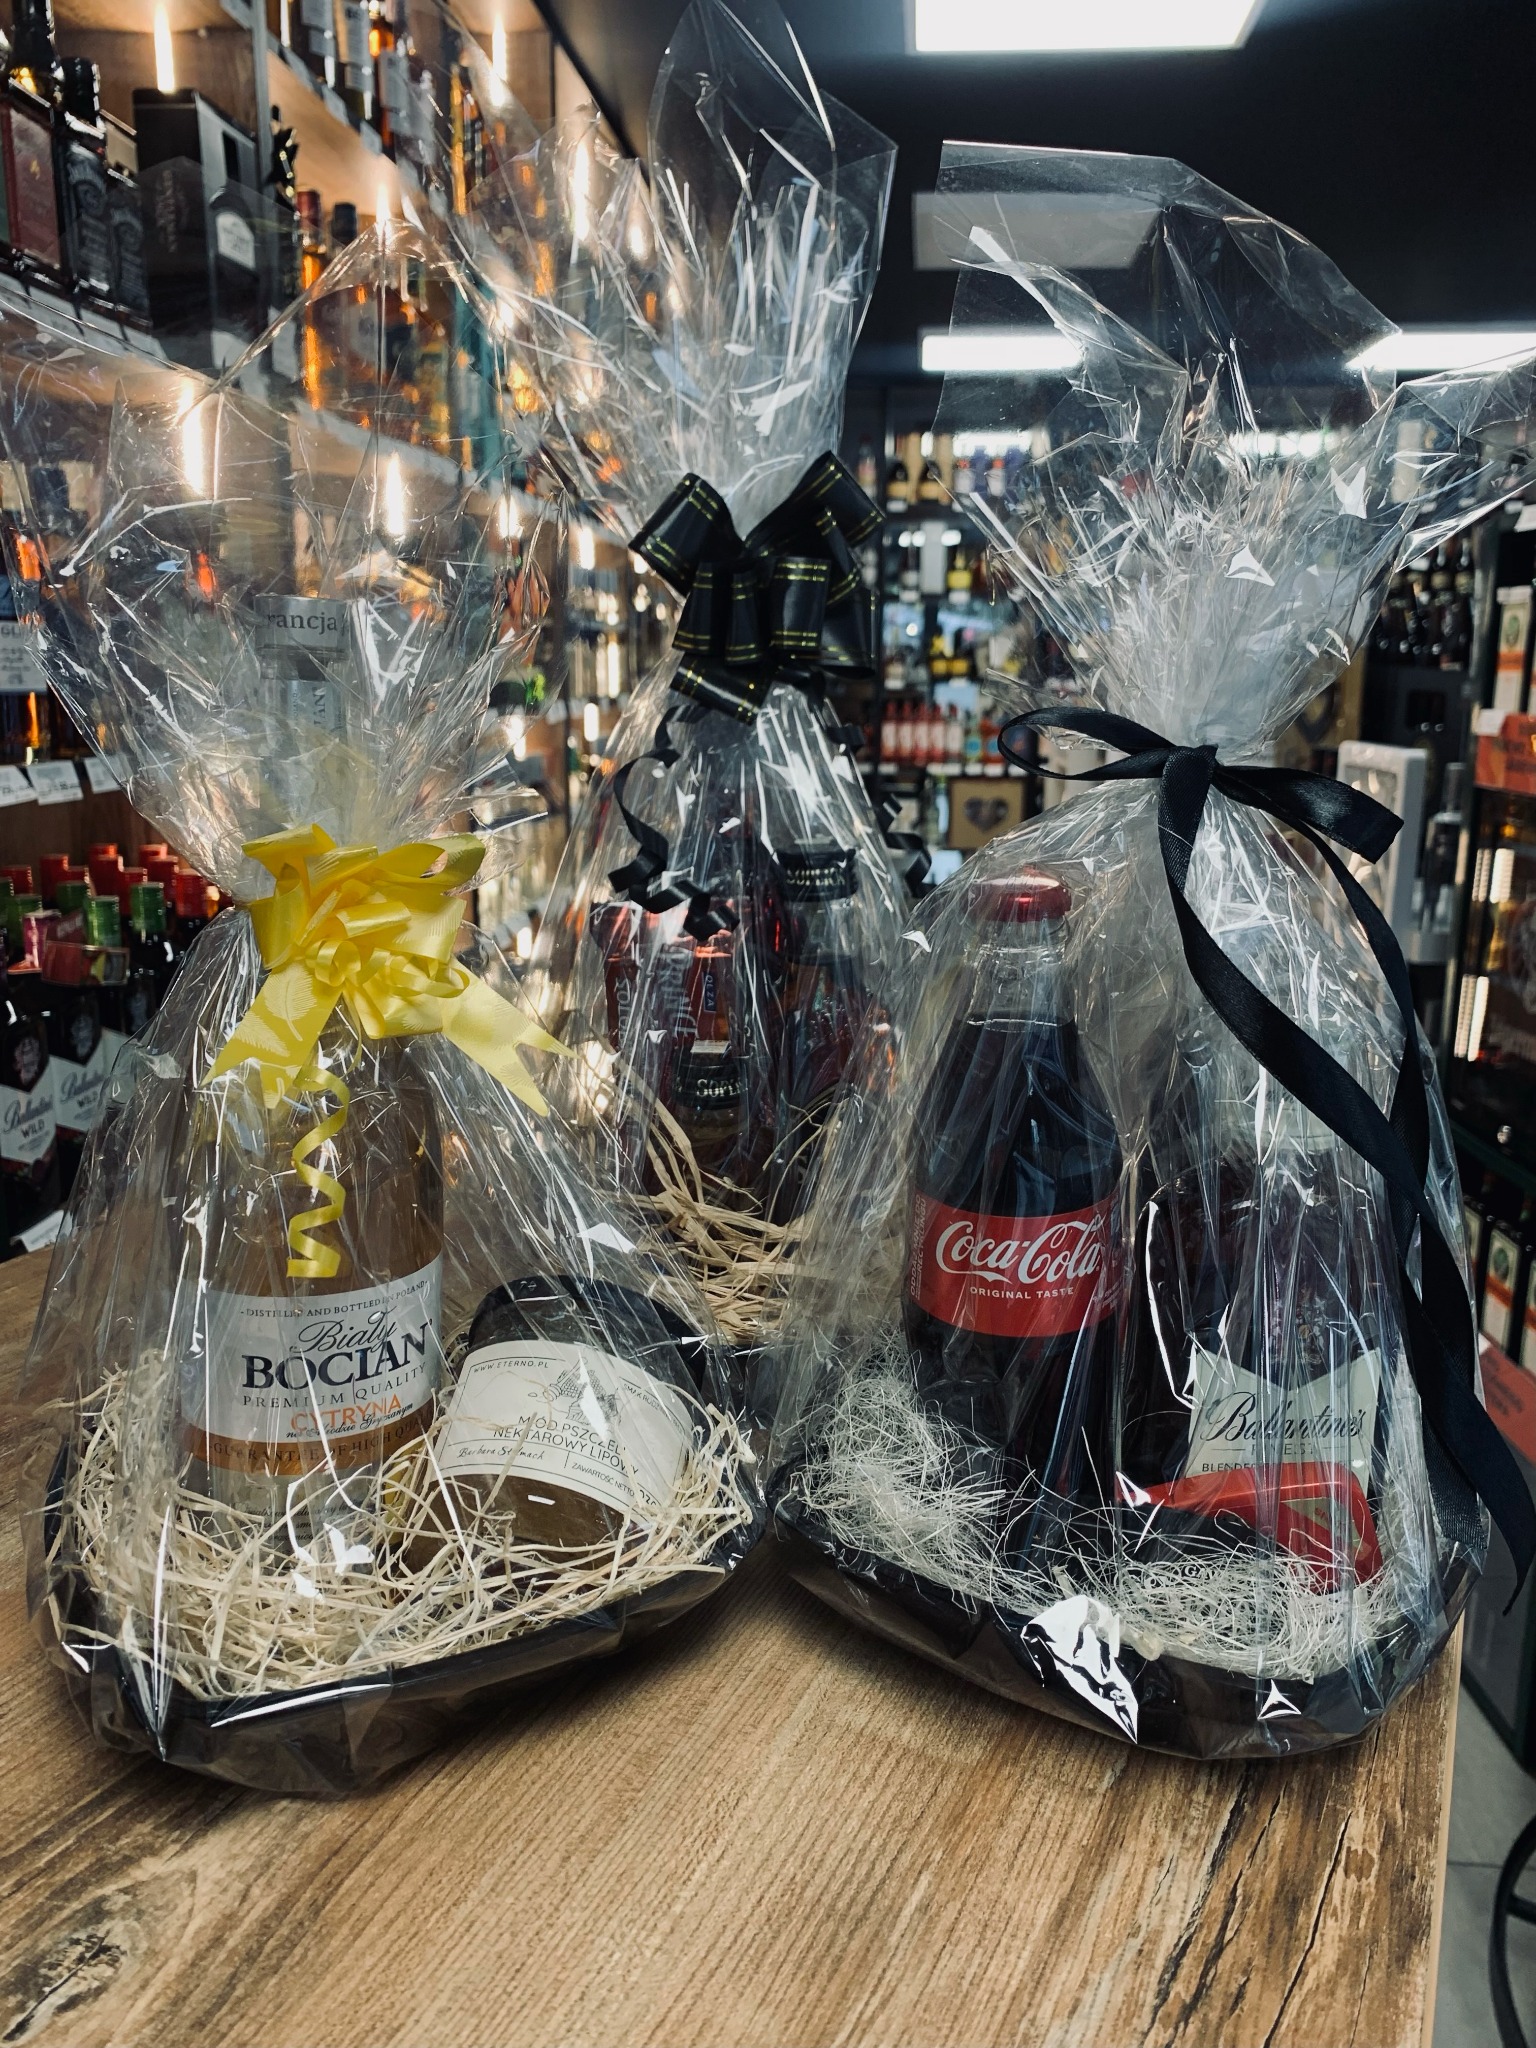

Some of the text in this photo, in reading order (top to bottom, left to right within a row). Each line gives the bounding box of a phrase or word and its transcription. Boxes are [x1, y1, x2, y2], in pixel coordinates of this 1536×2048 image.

[696, 1077, 748, 1098] SOPLI
[935, 1211, 1106, 1285] Coca-Cola
[970, 1286, 1074, 1299] ORIGINAL TASTE
[306, 1308, 331, 1317] AND
[334, 1299, 380, 1314] BOTTLED
[241, 1321, 430, 1391] BOCIAN
[243, 1362, 427, 1408] PREMIUM QUALITY
[290, 1394, 401, 1432] CYTRYNA
[518, 1415, 558, 1432] MÓD
[1200, 1391, 1366, 1442] Ballantine's
[351, 1435, 391, 1451] HIGH
[493, 1423, 588, 1452] NEKTAROWY
[457, 1444, 545, 1460] Barbara Stlmach
[1251, 1443, 1315, 1456] FNEST
[1202, 1461, 1258, 1473] BLENDE
[571, 1462, 614, 1486] ZAWARTOŚĆ
[614, 1480, 635, 1497] NETTO
